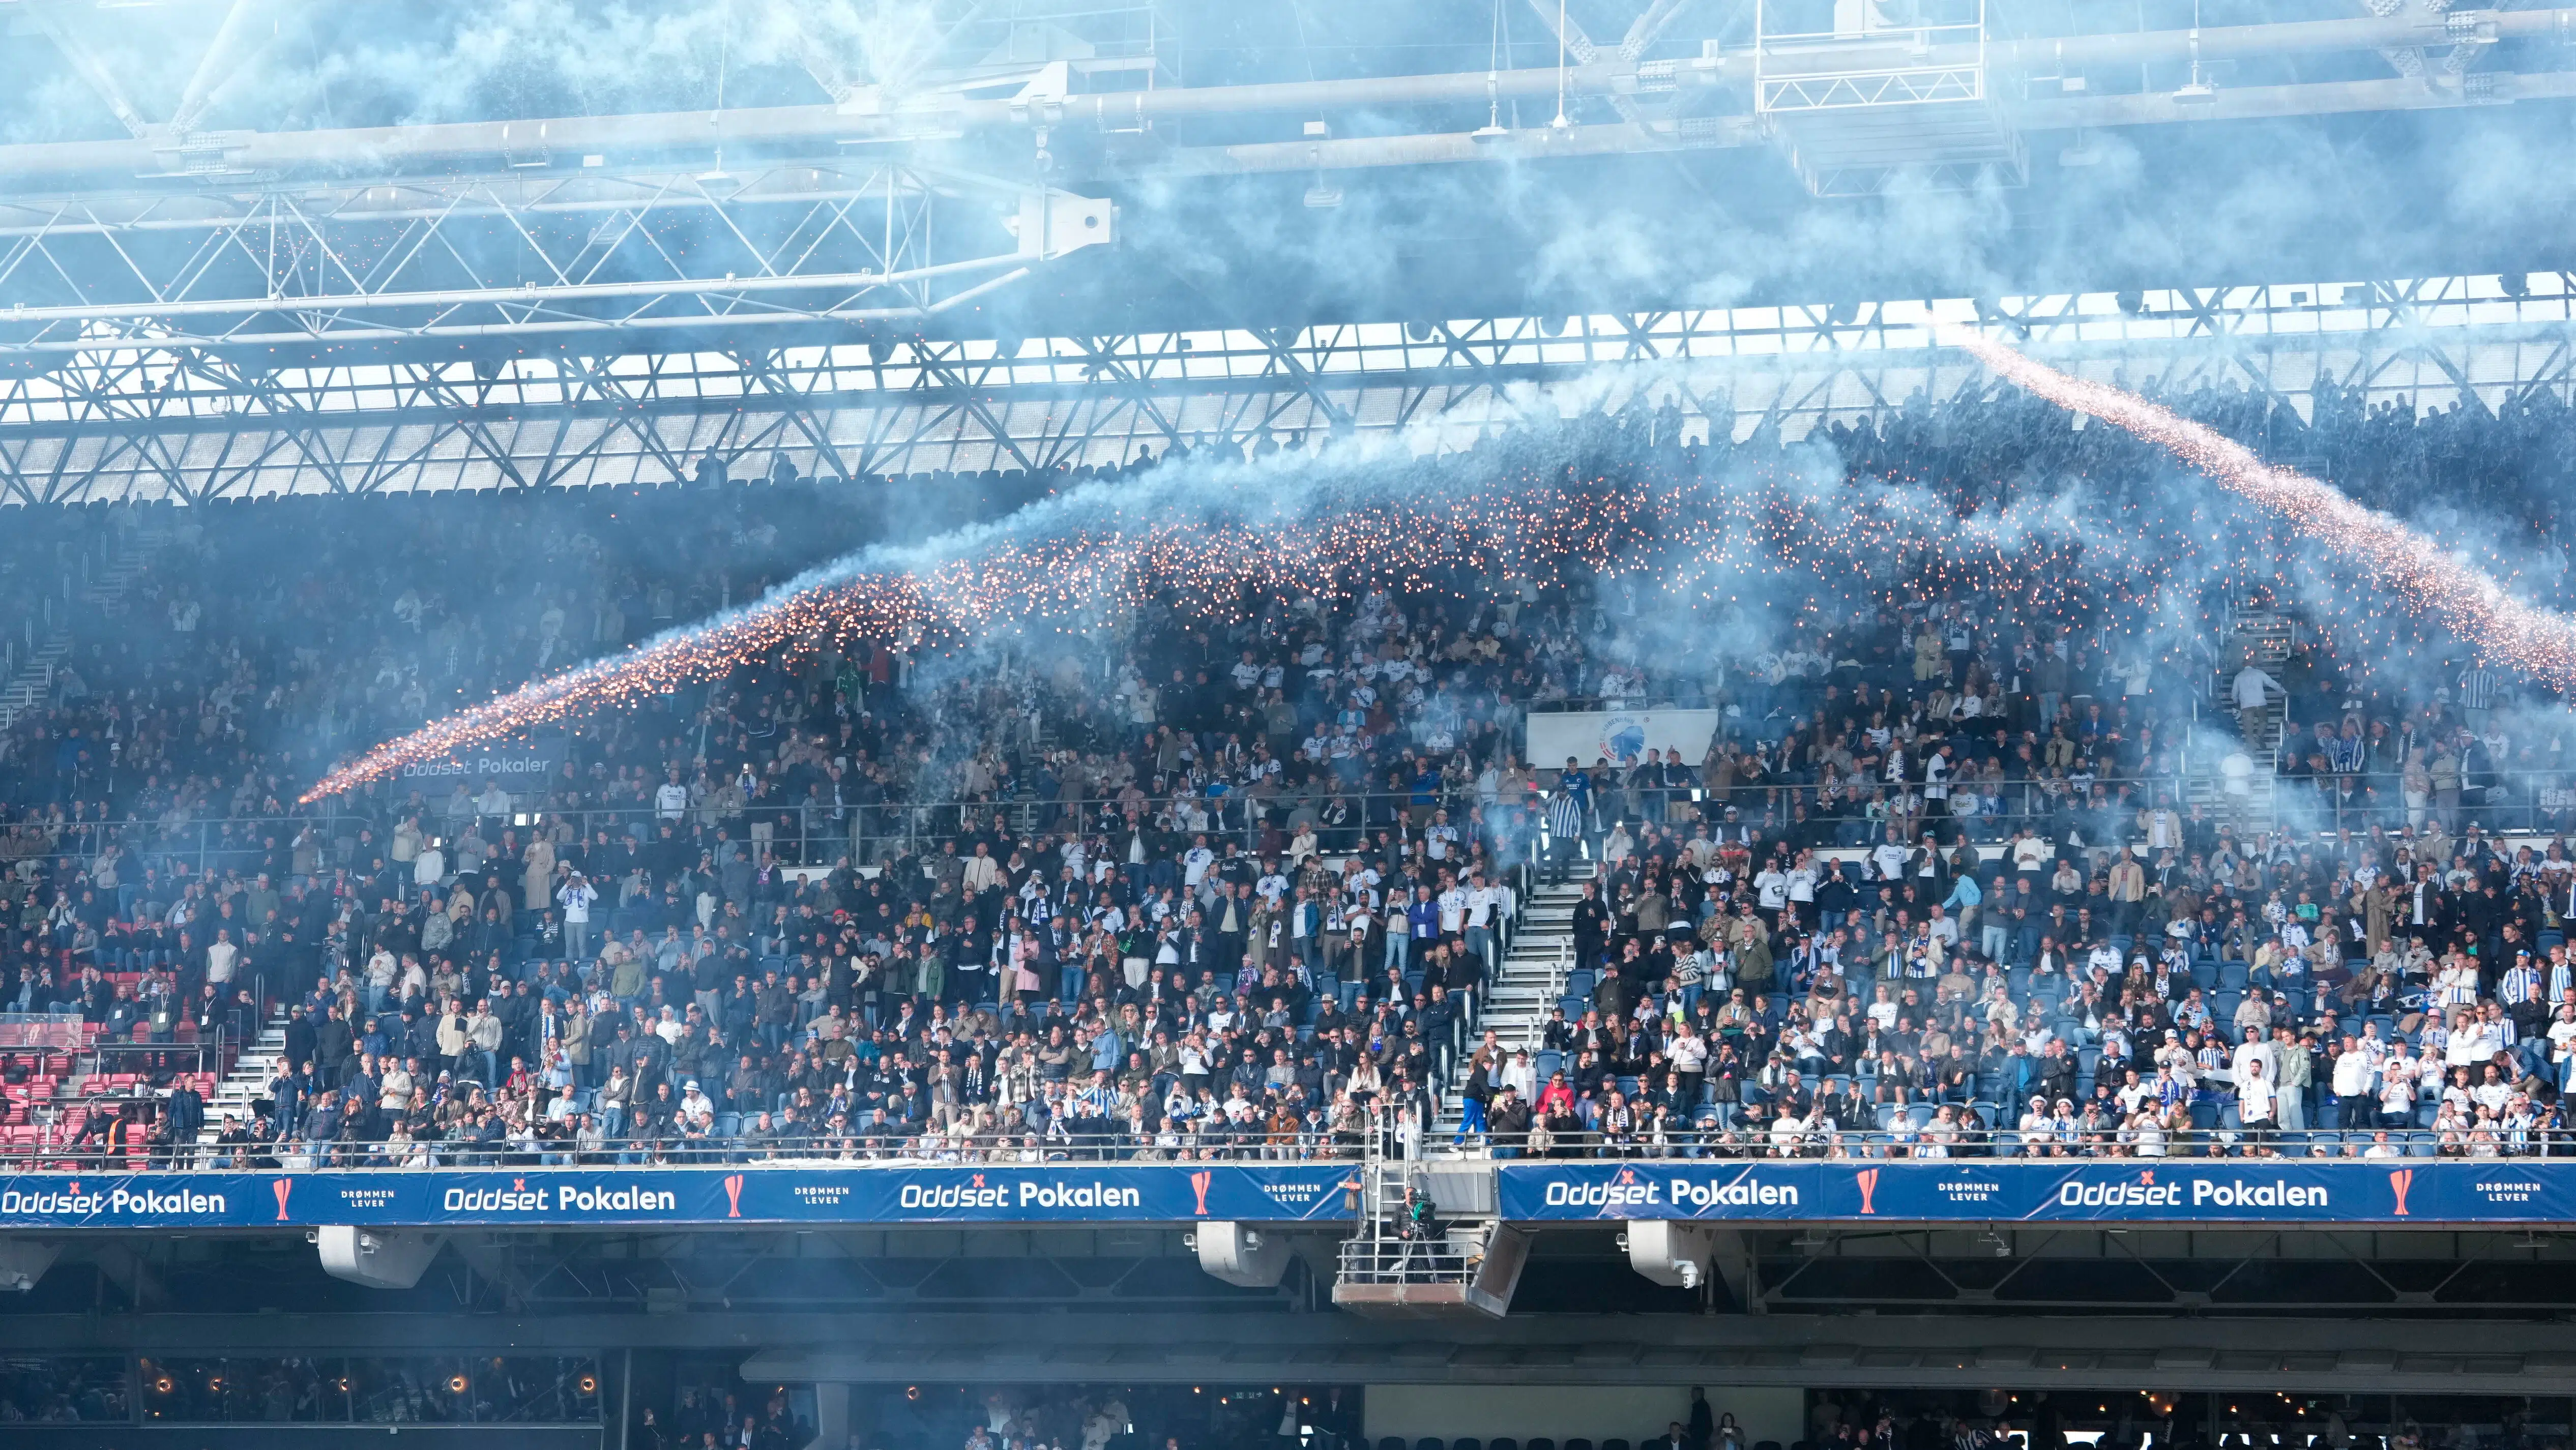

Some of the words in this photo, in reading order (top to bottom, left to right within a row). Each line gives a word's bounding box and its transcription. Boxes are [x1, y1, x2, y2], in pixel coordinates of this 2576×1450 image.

[1602, 716, 1635, 732] KØBENHAVN
[405, 761, 472, 777] Oddset
[795, 1187, 848, 1195] DRØMMEN
[1264, 1184, 1321, 1193] DRØMMEN
[1939, 1183, 1999, 1191] DRØMMEN
[2477, 1183, 2540, 1192] DRØMMEN
[341, 1190, 394, 1199] DRØMMEN
[901, 1185, 1009, 1208] Oddset
[1020, 1182, 1140, 1207] Pokalen
[1546, 1182, 1659, 1205] Oddset
[1672, 1179, 1798, 1205] Pokalen
[2060, 1181, 2181, 1206] Oddset
[2193, 1179, 2327, 1206] Pokalen
[2, 1191, 103, 1214] Oddset
[112, 1189, 225, 1214] Pokalen
[444, 1189, 549, 1211] Oddset
[560, 1186, 675, 1210] Pokalen
[1950, 1193, 1987, 1201] LEVER
[2489, 1193, 2529, 1202] LEVER
[352, 1199, 385, 1207] LEVER
